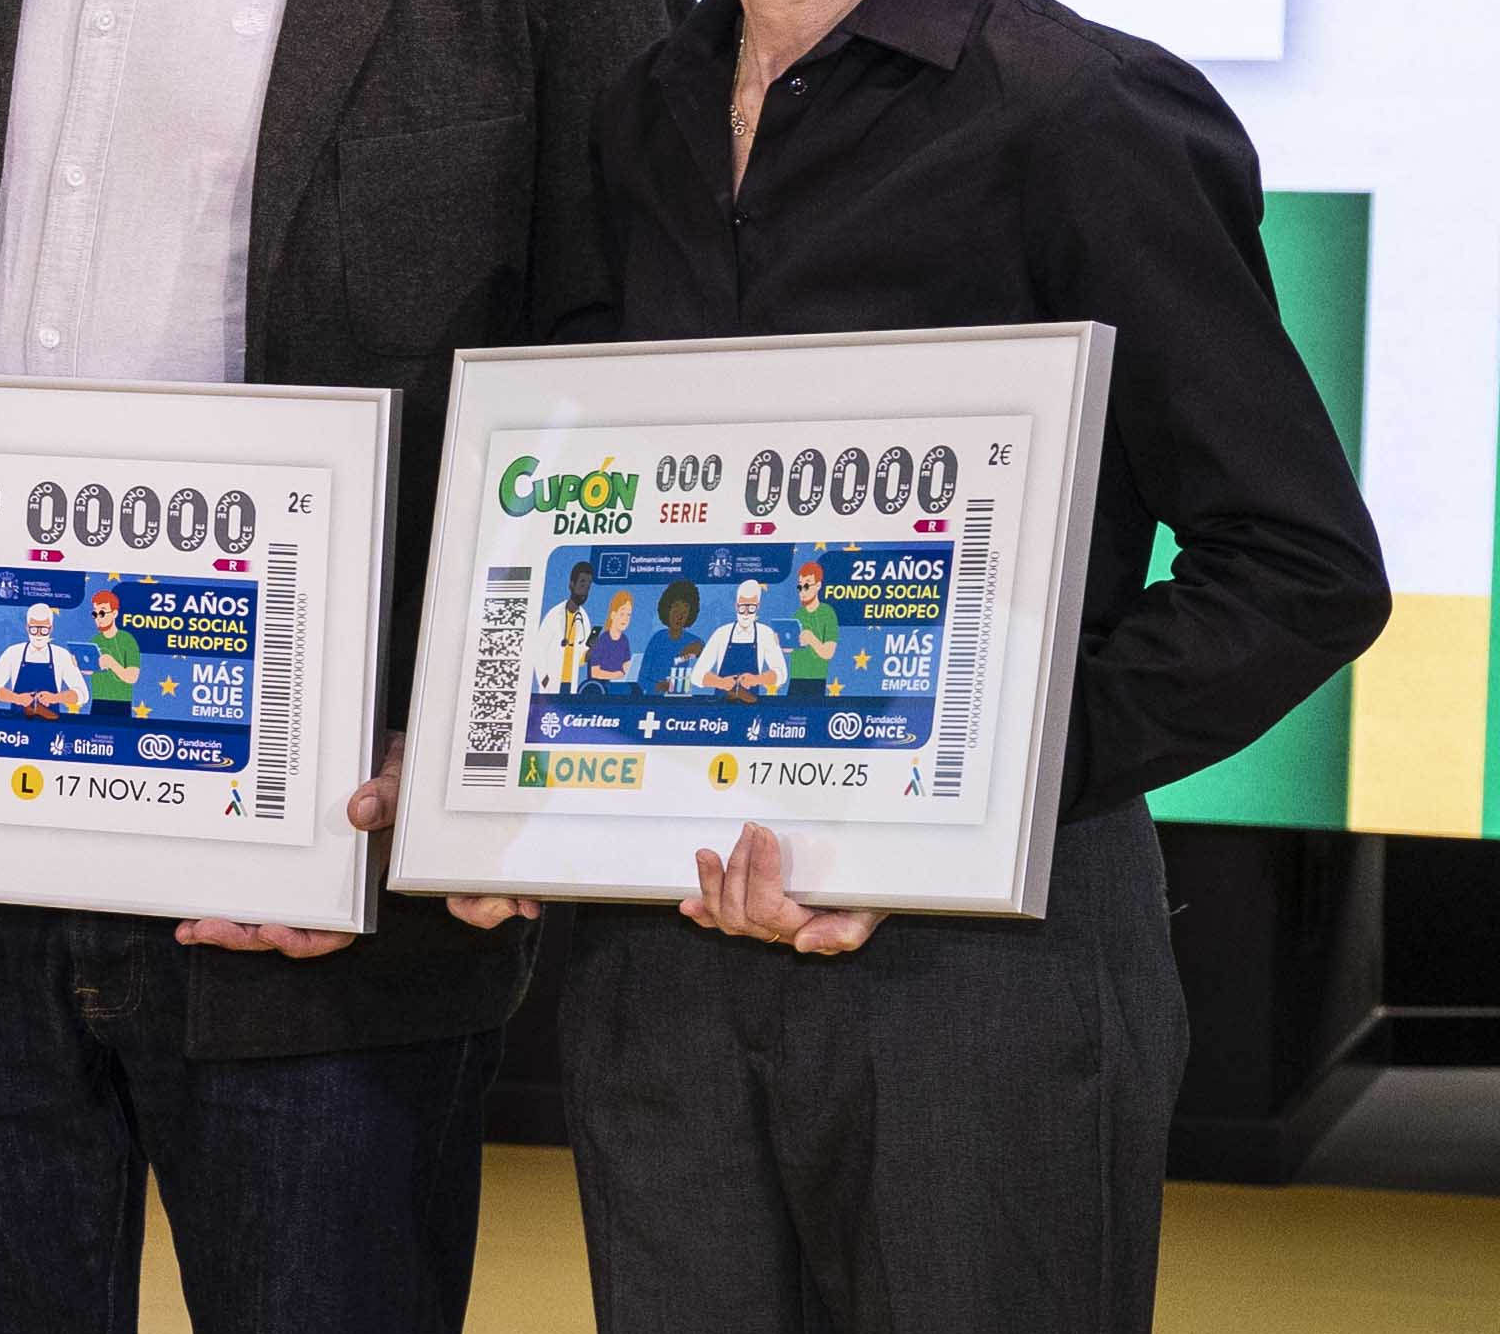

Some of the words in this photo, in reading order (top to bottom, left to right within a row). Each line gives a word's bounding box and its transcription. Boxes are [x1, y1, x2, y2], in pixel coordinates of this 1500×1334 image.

[987, 442, 1013, 465] 2€
[287, 491, 313, 514] 2€
[659, 502, 708, 523] SERIE
[850, 560, 876, 580] 25
[881, 555, 945, 580] AÑOS
[824, 584, 882, 599] FONDO
[885, 583, 941, 599] SOCIAL
[149, 592, 175, 612] 25
[182, 590, 249, 617] AÑOS
[863, 603, 939, 619] EUROPEO
[122, 613, 184, 630] FONDO
[188, 616, 247, 634] SOCIAL
[167, 633, 247, 652] EUROPEO
[884, 628, 934, 654] MÁS
[192, 658, 244, 685] MÁS
[881, 656, 931, 678] QUE
[881, 678, 930, 691] EMPLEO
[191, 684, 243, 707] QUE
[192, 705, 243, 719] EMPLEO
[562, 714, 620, 728] Cáritas
[865, 714, 907, 724] Fundación
[665, 718, 696, 731] Cruz
[699, 718, 729, 734] Roja
[768, 721, 806, 738] Gitano
[863, 724, 905, 738] ONCE
[73, 738, 114, 756] Gitano
[178, 737, 222, 749] Fundación
[176, 746, 221, 762] ONCE
[553, 756, 638, 783] ONCE
[716, 761, 730, 783] L
[747, 762, 772, 784] 17
[779, 762, 838, 785] NOV.
[842, 763, 869, 786] 25
[54, 774, 80, 796] 17
[89, 776, 151, 802] NOV.
[157, 782, 185, 804] 25
